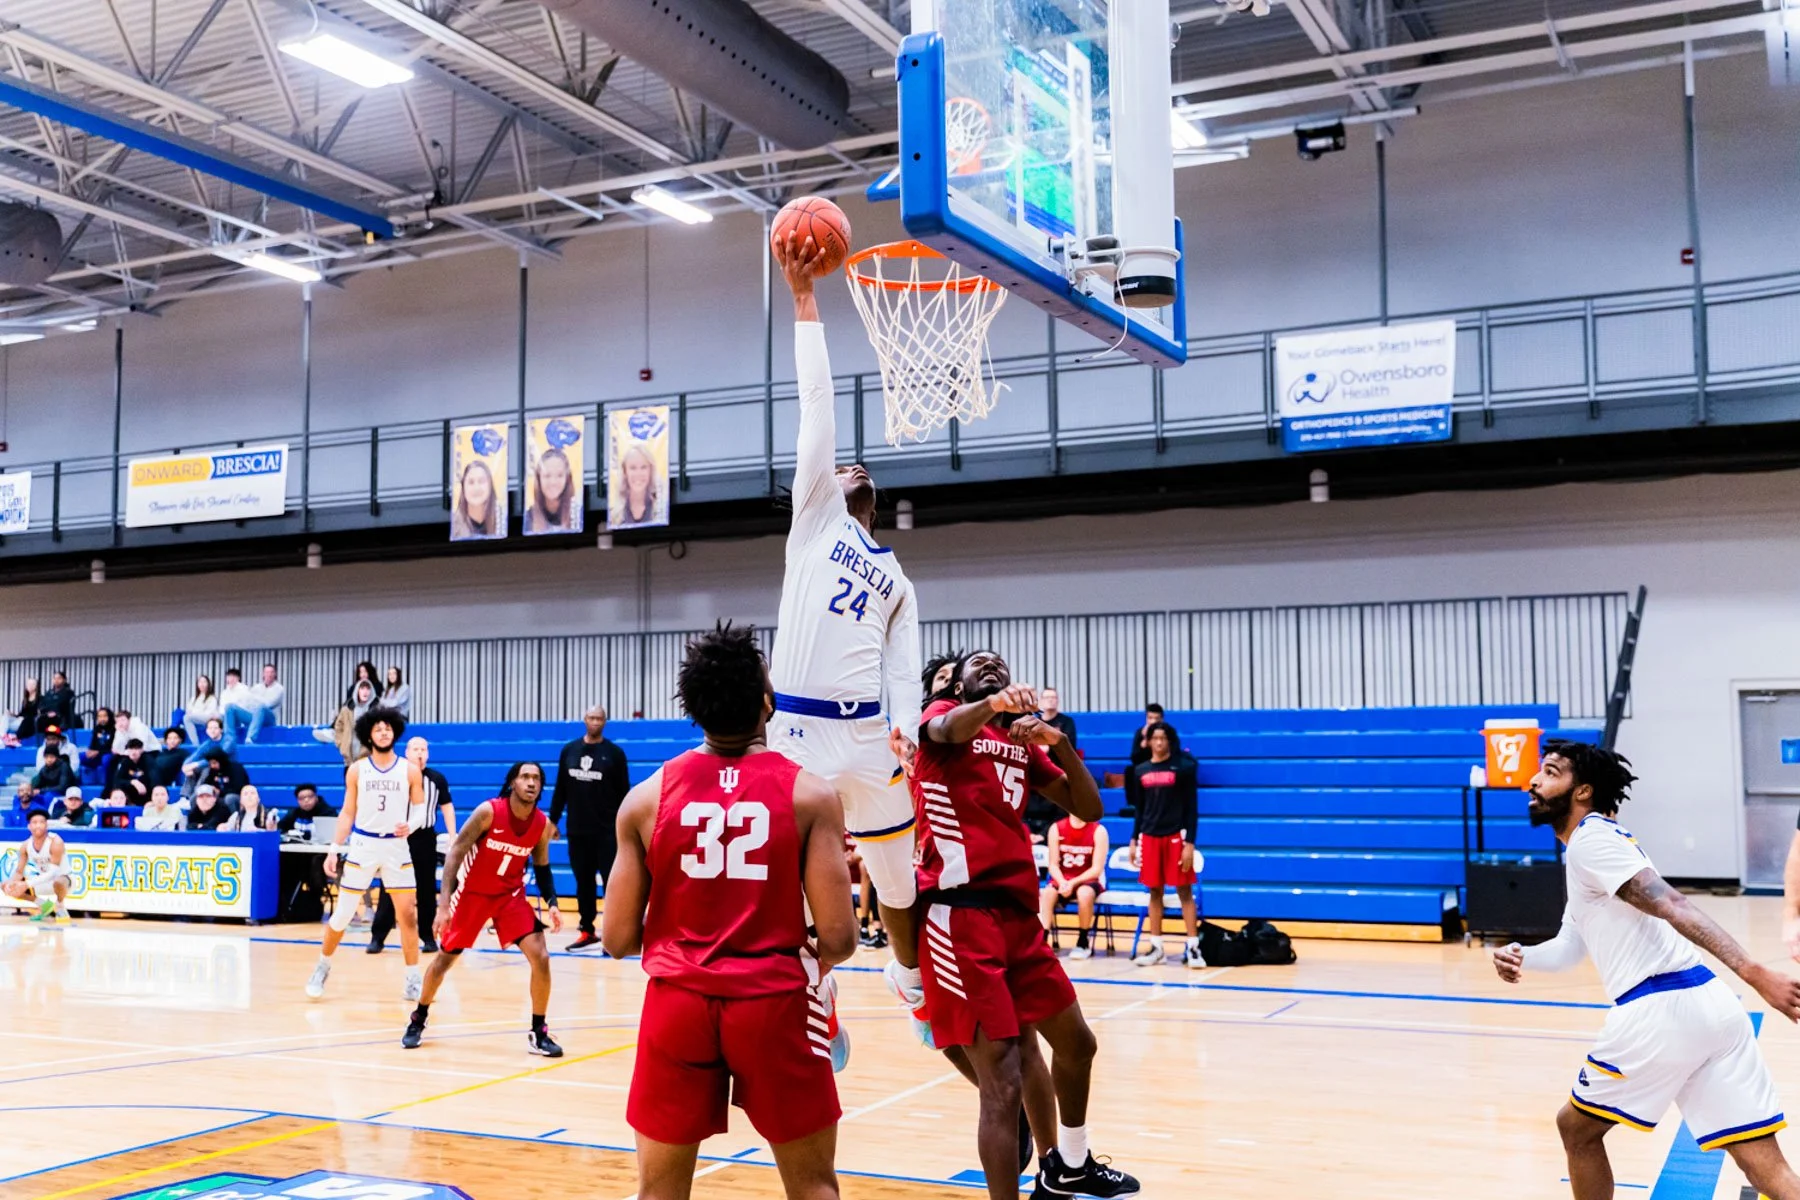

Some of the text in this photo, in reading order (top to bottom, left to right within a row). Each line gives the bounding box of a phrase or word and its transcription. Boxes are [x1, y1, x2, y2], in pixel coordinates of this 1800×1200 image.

[1314, 345, 1374, 358] Comeback
[1340, 364, 1448, 385] Owensboro
[1342, 386, 1390, 399] Health
[1363, 411, 1399, 425] SPORTS
[1399, 408, 1445, 422] MEDICINE
[215, 452, 281, 475] BRESCIA!
[829, 540, 894, 600] BRESCIA
[828, 577, 869, 621] 24
[365, 779, 401, 792] BRESCIA
[377, 794, 387, 812] 3
[681, 801, 770, 881] 32
[496, 854, 513, 877] 1
[66, 849, 242, 906] BEARCATS
